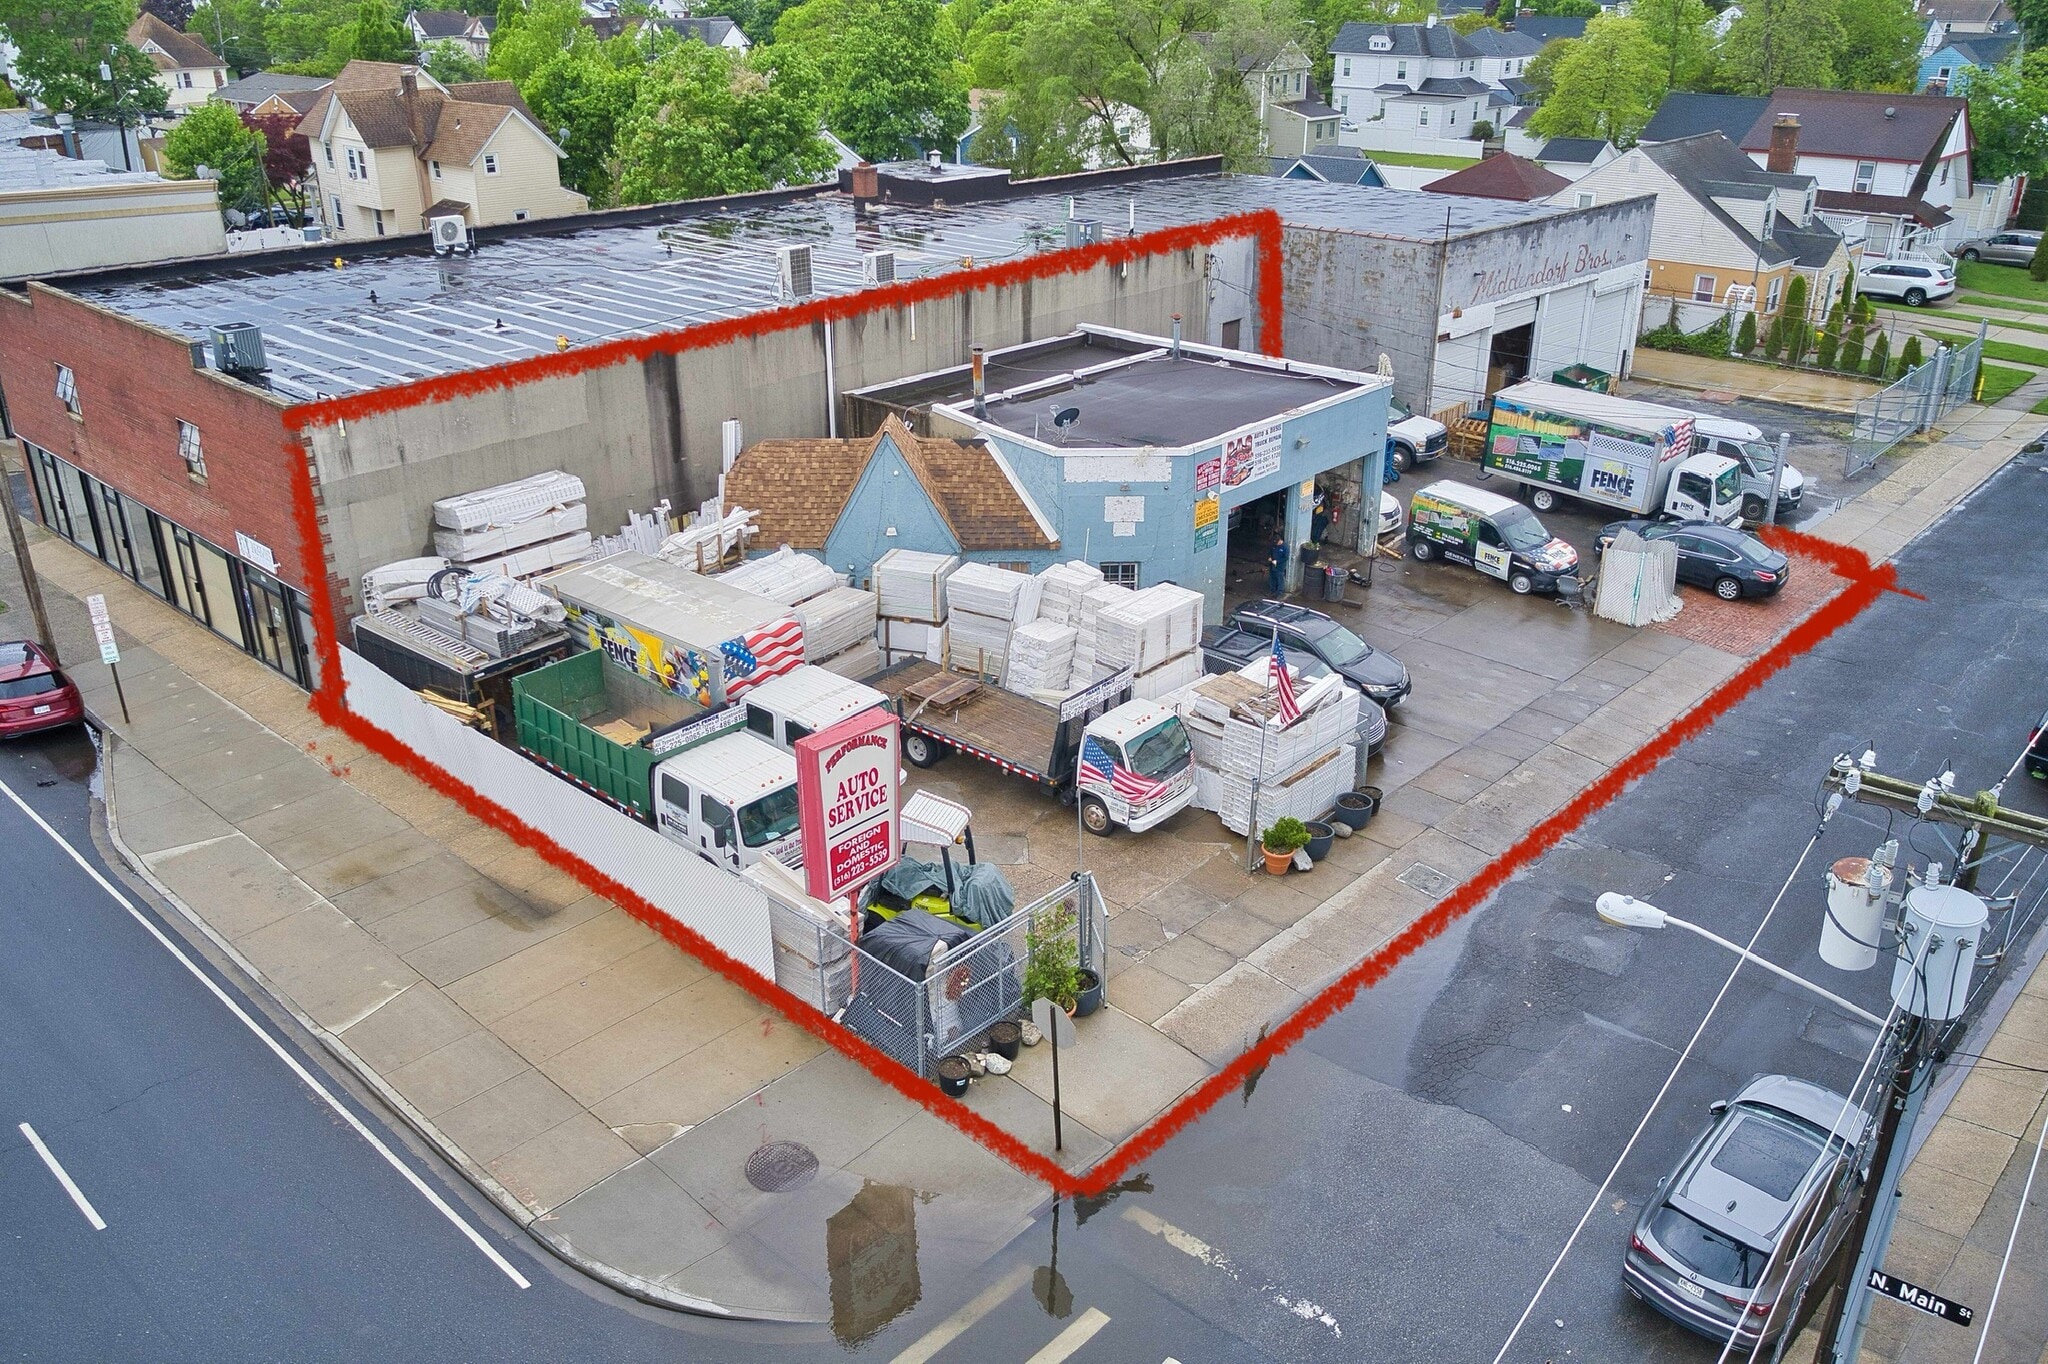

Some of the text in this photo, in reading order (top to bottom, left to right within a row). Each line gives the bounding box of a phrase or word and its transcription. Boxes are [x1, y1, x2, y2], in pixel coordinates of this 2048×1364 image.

[1470, 251, 1569, 305] Middendorf
[1590, 469, 1635, 497] FENCE
[1680, 501, 1694, 511] FENCE
[1444, 551, 1471, 563] GENERAL
[1484, 552, 1501, 565] FENCE
[600, 637, 639, 673] FENCE
[681, 721, 700, 733] FRANK
[701, 714, 719, 724] FENCE
[825, 734, 888, 774] PERFORMANCE
[836, 767, 880, 803] AUTO
[828, 784, 888, 829] SERVICE
[838, 825, 882, 854] FOREIGN
[849, 840, 870, 857] AND
[833, 849, 888, 887] (516) 223-5539
[836, 840, 885, 871] DOMESTIC
[1871, 1272, 1973, 1320] N. Main St
